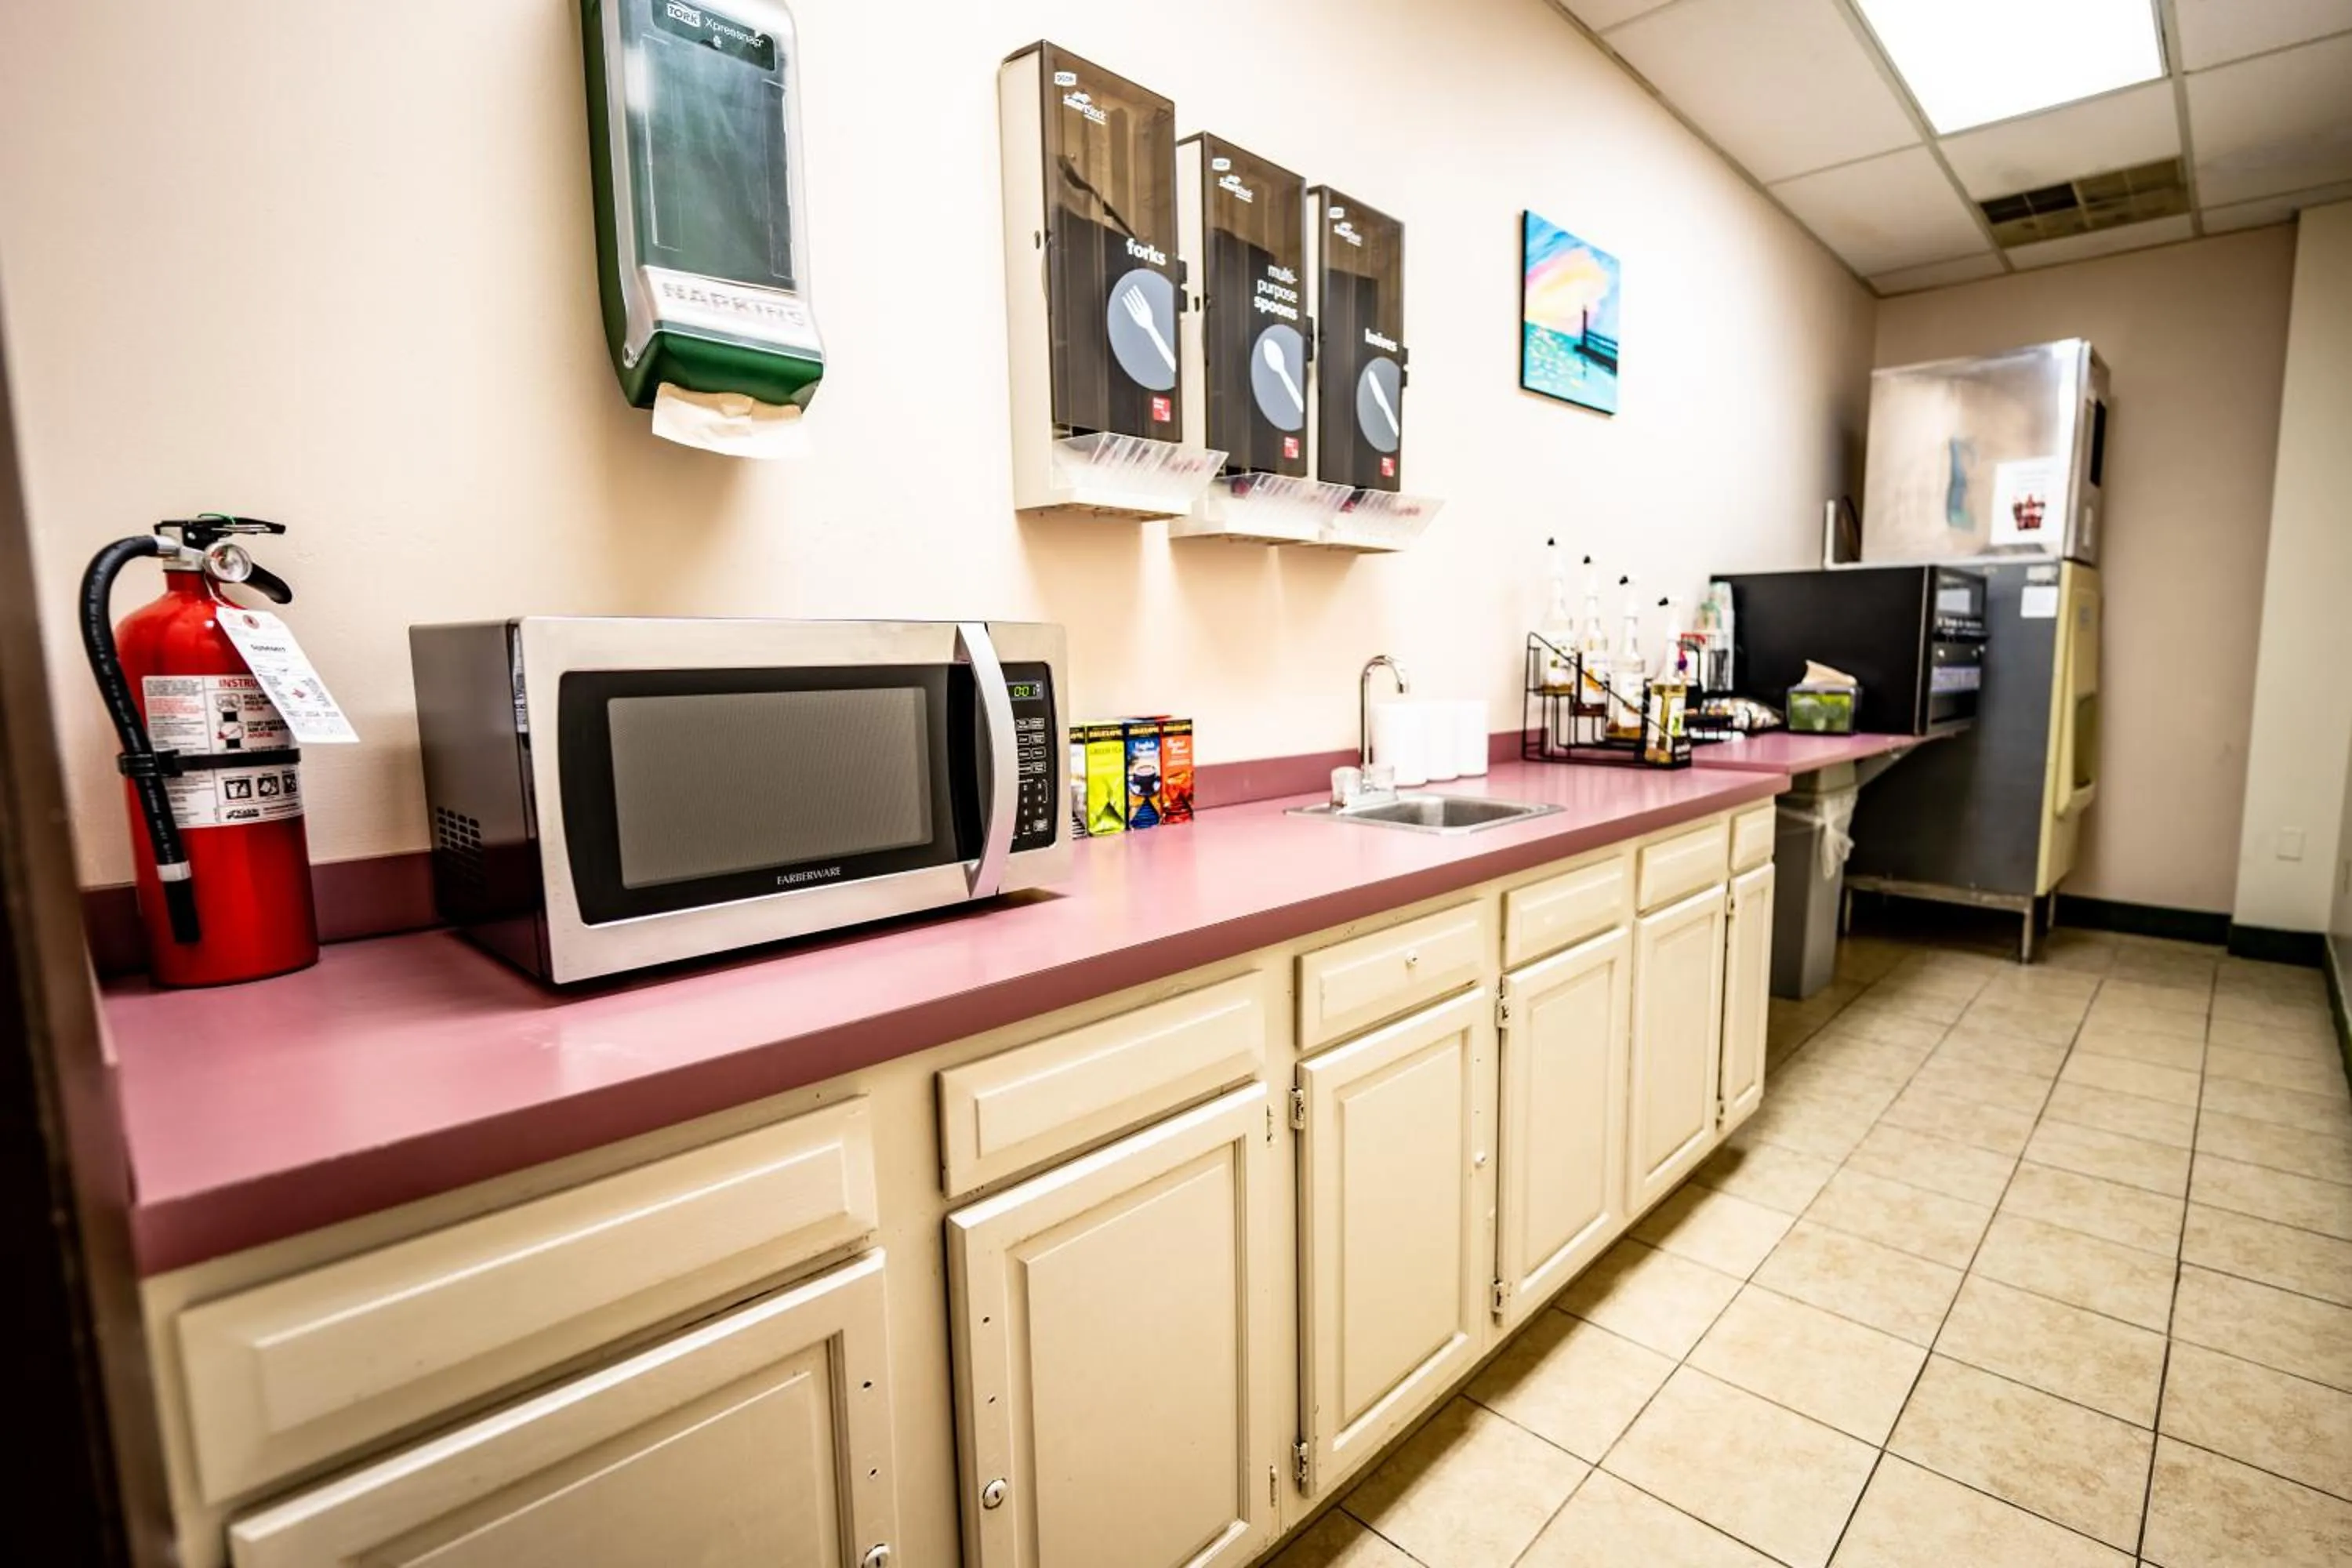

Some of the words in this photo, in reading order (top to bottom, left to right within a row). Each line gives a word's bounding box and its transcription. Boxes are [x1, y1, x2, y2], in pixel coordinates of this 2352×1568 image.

[668, 5, 699, 25] TORK
[1126, 238, 1167, 267] forks
[1257, 278, 1298, 304] purpose
[1254, 295, 1299, 321] spoons
[219, 678, 259, 688] INSTRU
[776, 866, 841, 885] FARBERWARE
